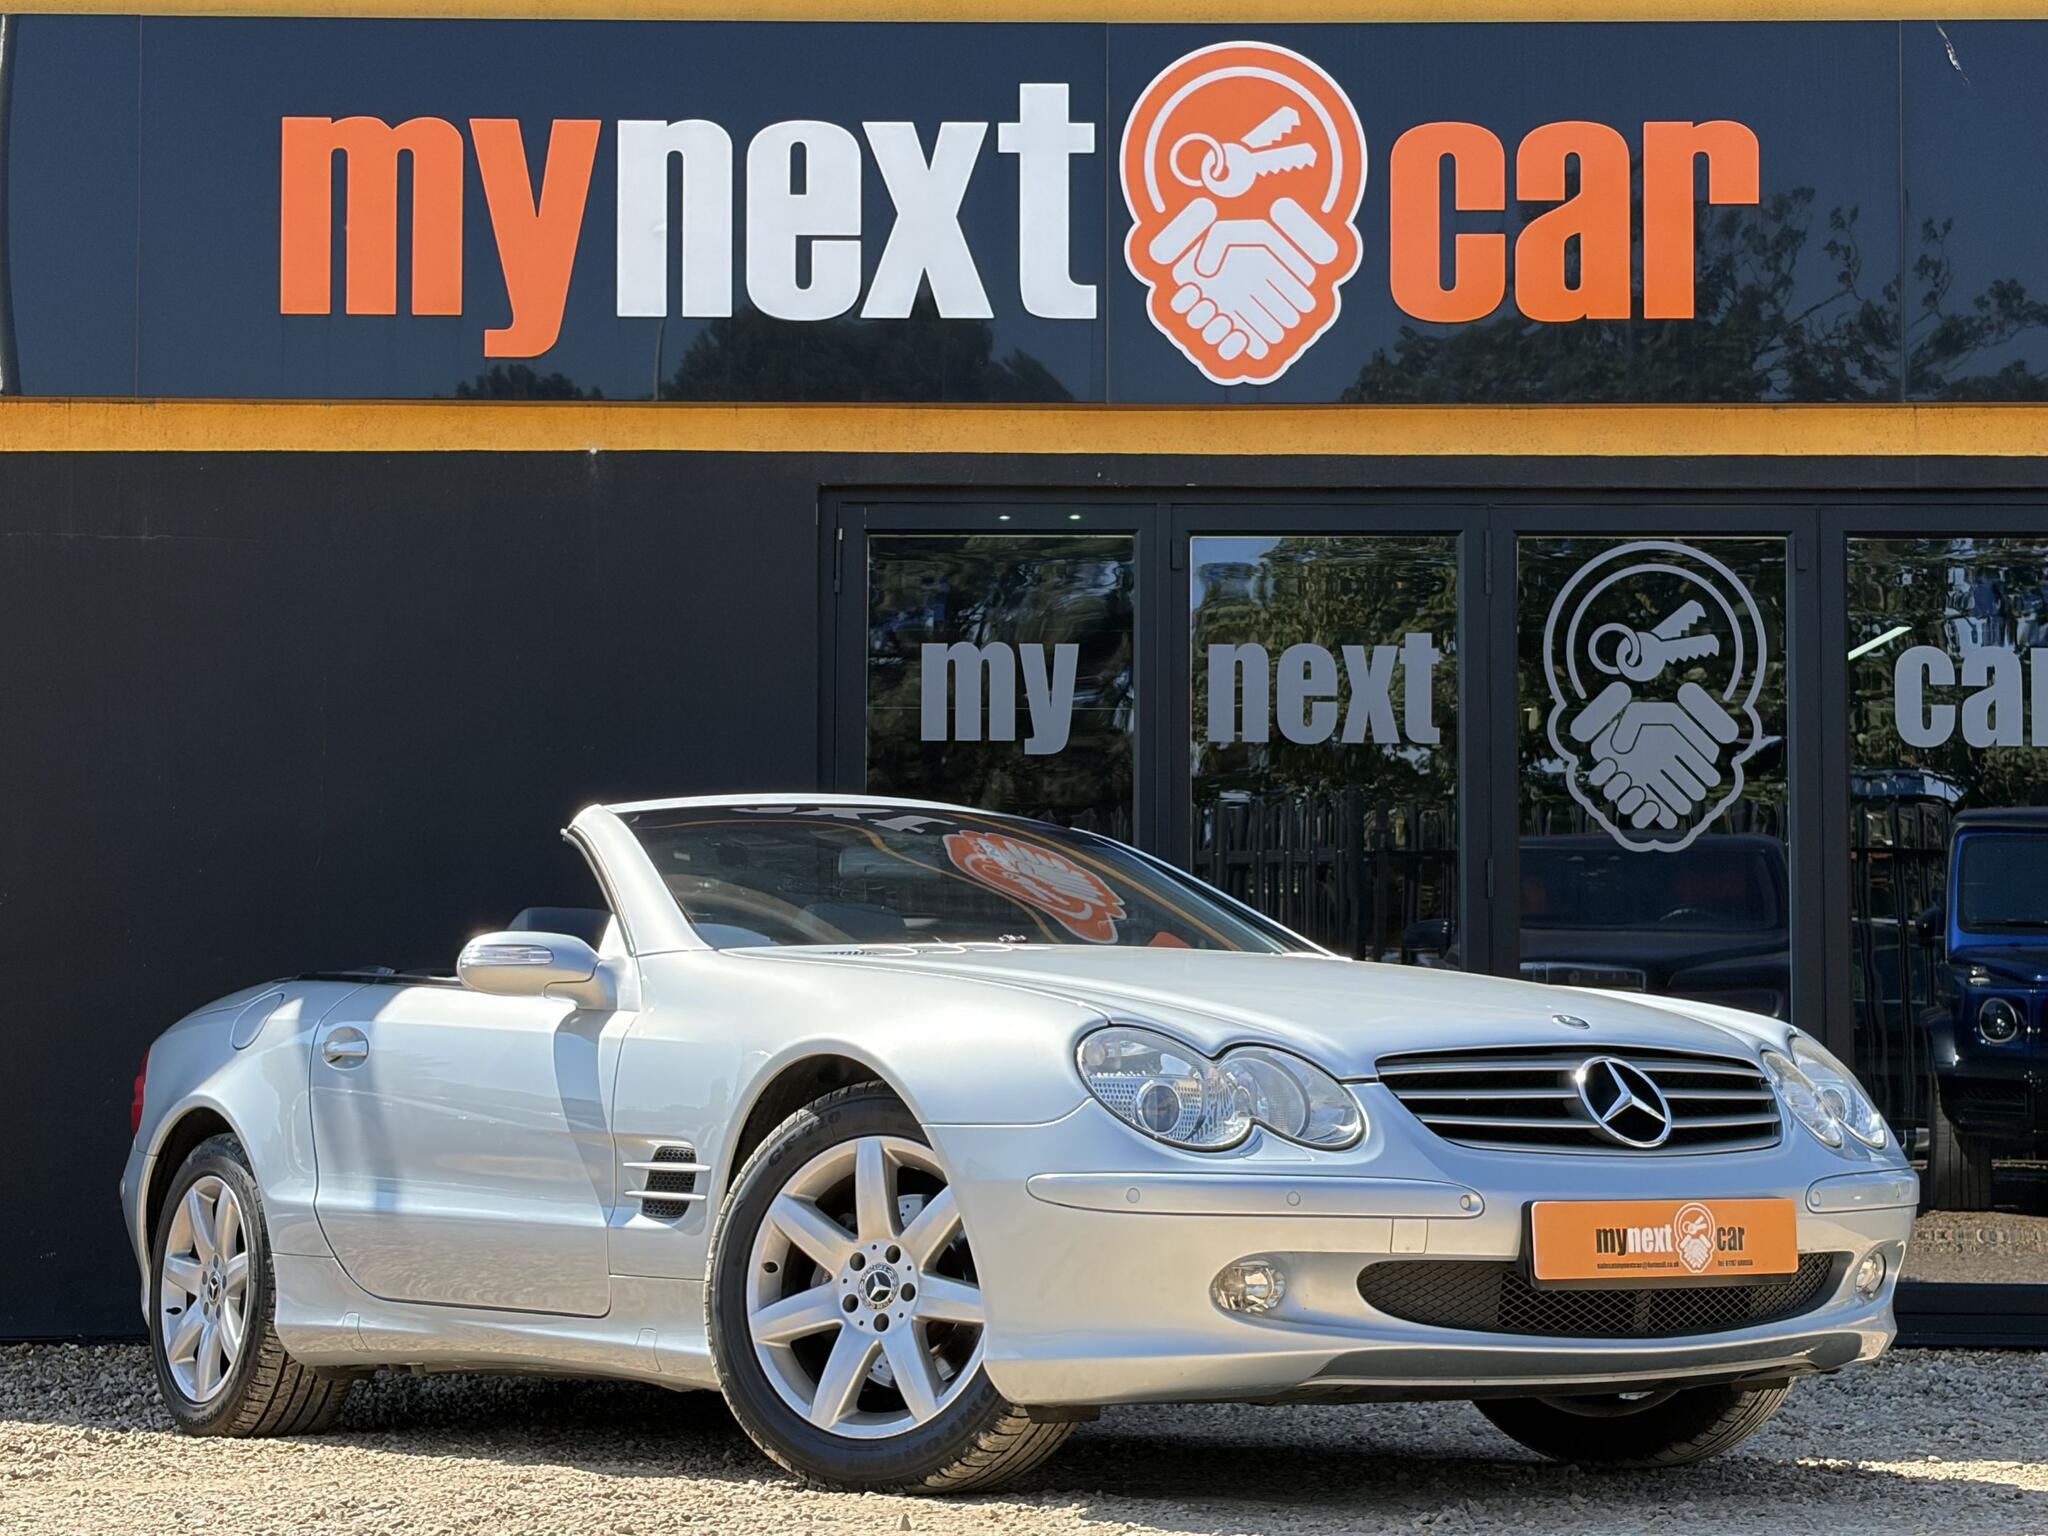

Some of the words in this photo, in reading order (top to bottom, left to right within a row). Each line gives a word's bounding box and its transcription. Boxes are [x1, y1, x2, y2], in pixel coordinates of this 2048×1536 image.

[1389, 120, 1760, 322] car
[920, 641, 1079, 755] my
[1207, 632, 1441, 745] next
[1894, 645, 2048, 749] ca
[1716, 1226, 1745, 1251] car
